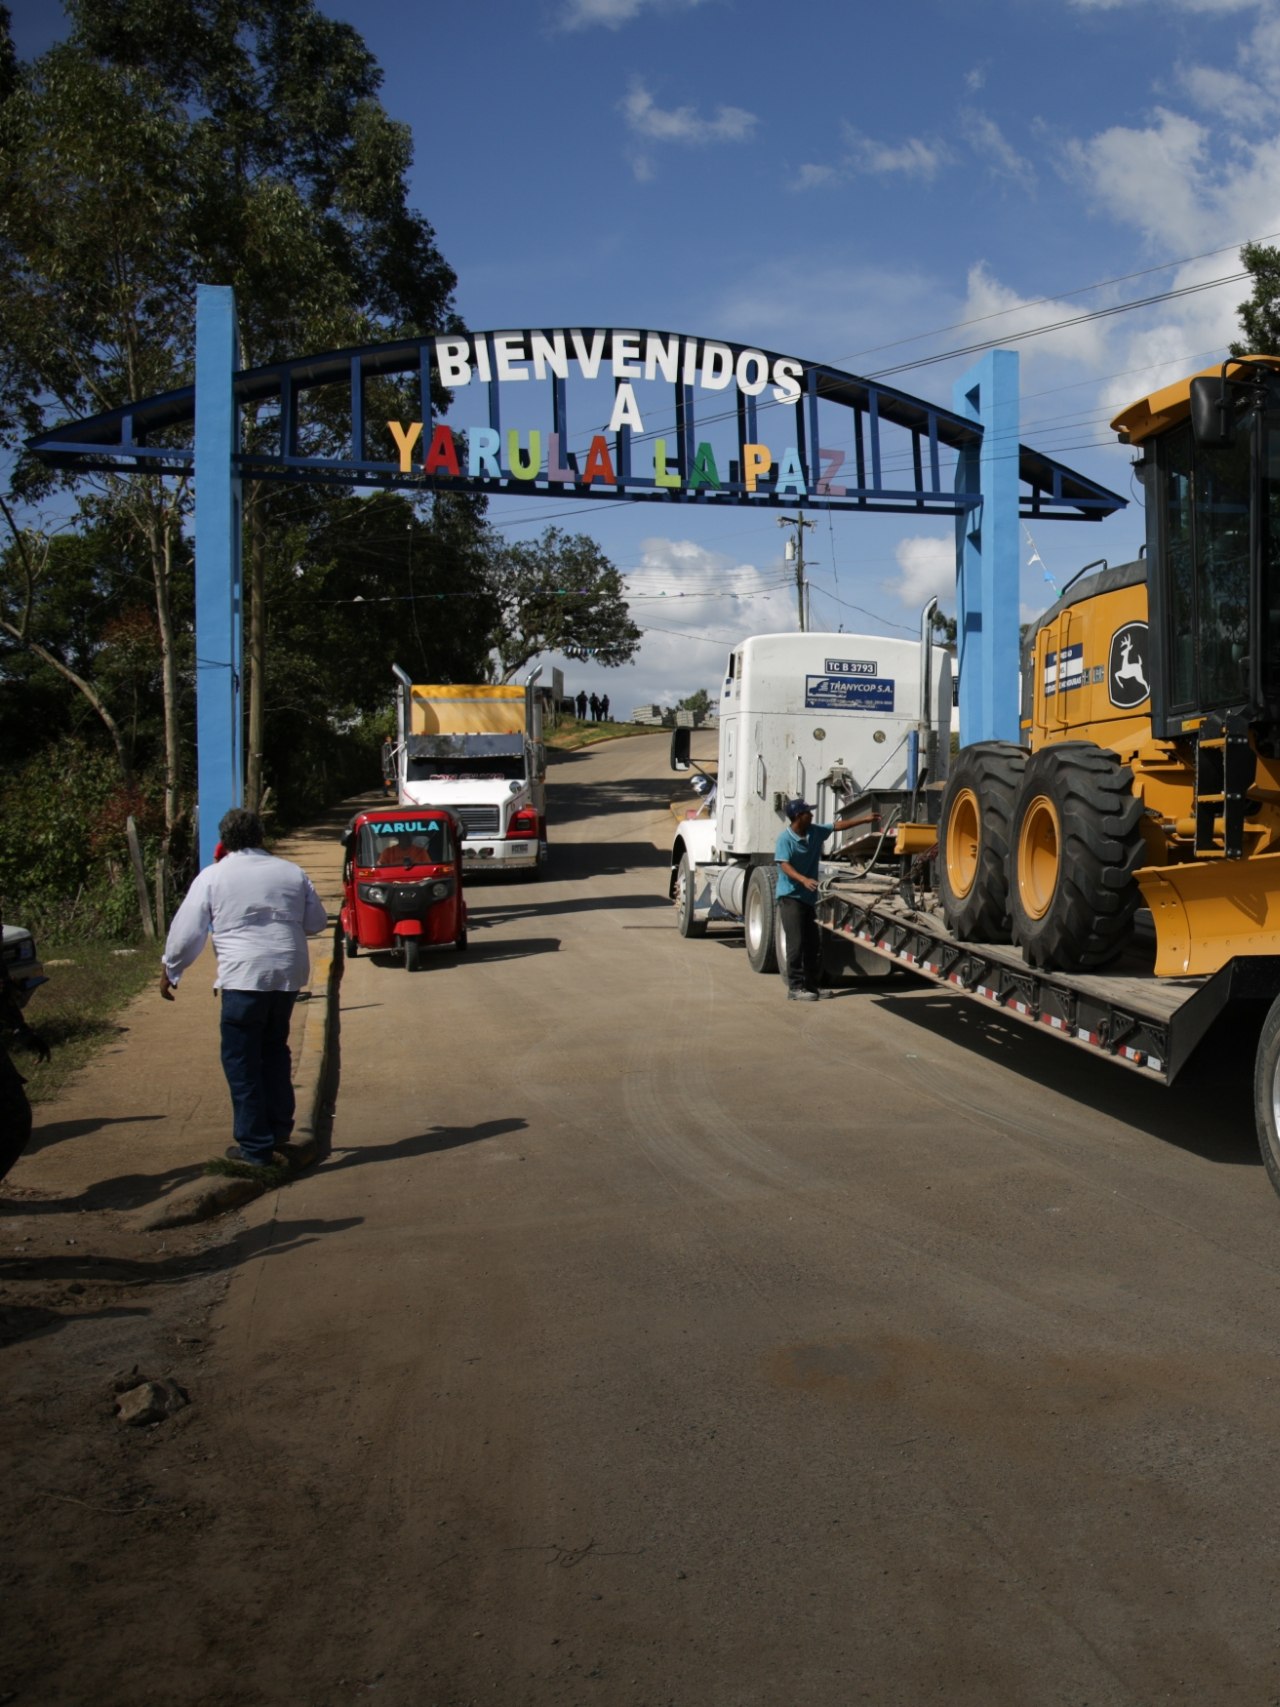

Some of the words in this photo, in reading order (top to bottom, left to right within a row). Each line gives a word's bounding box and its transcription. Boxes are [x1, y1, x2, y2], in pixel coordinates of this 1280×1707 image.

[434, 328, 804, 405] BIENVENIDOS
[608, 383, 645, 433] A
[387, 420, 618, 486] YARULA
[654, 438, 722, 491] LA
[743, 442, 847, 496] PAZ
[828, 661, 840, 671] TC
[842, 662, 849, 672] B
[850, 663, 874, 673] 3793
[877, 684, 893, 693] S.A.
[371, 820, 440, 834] YARULA
